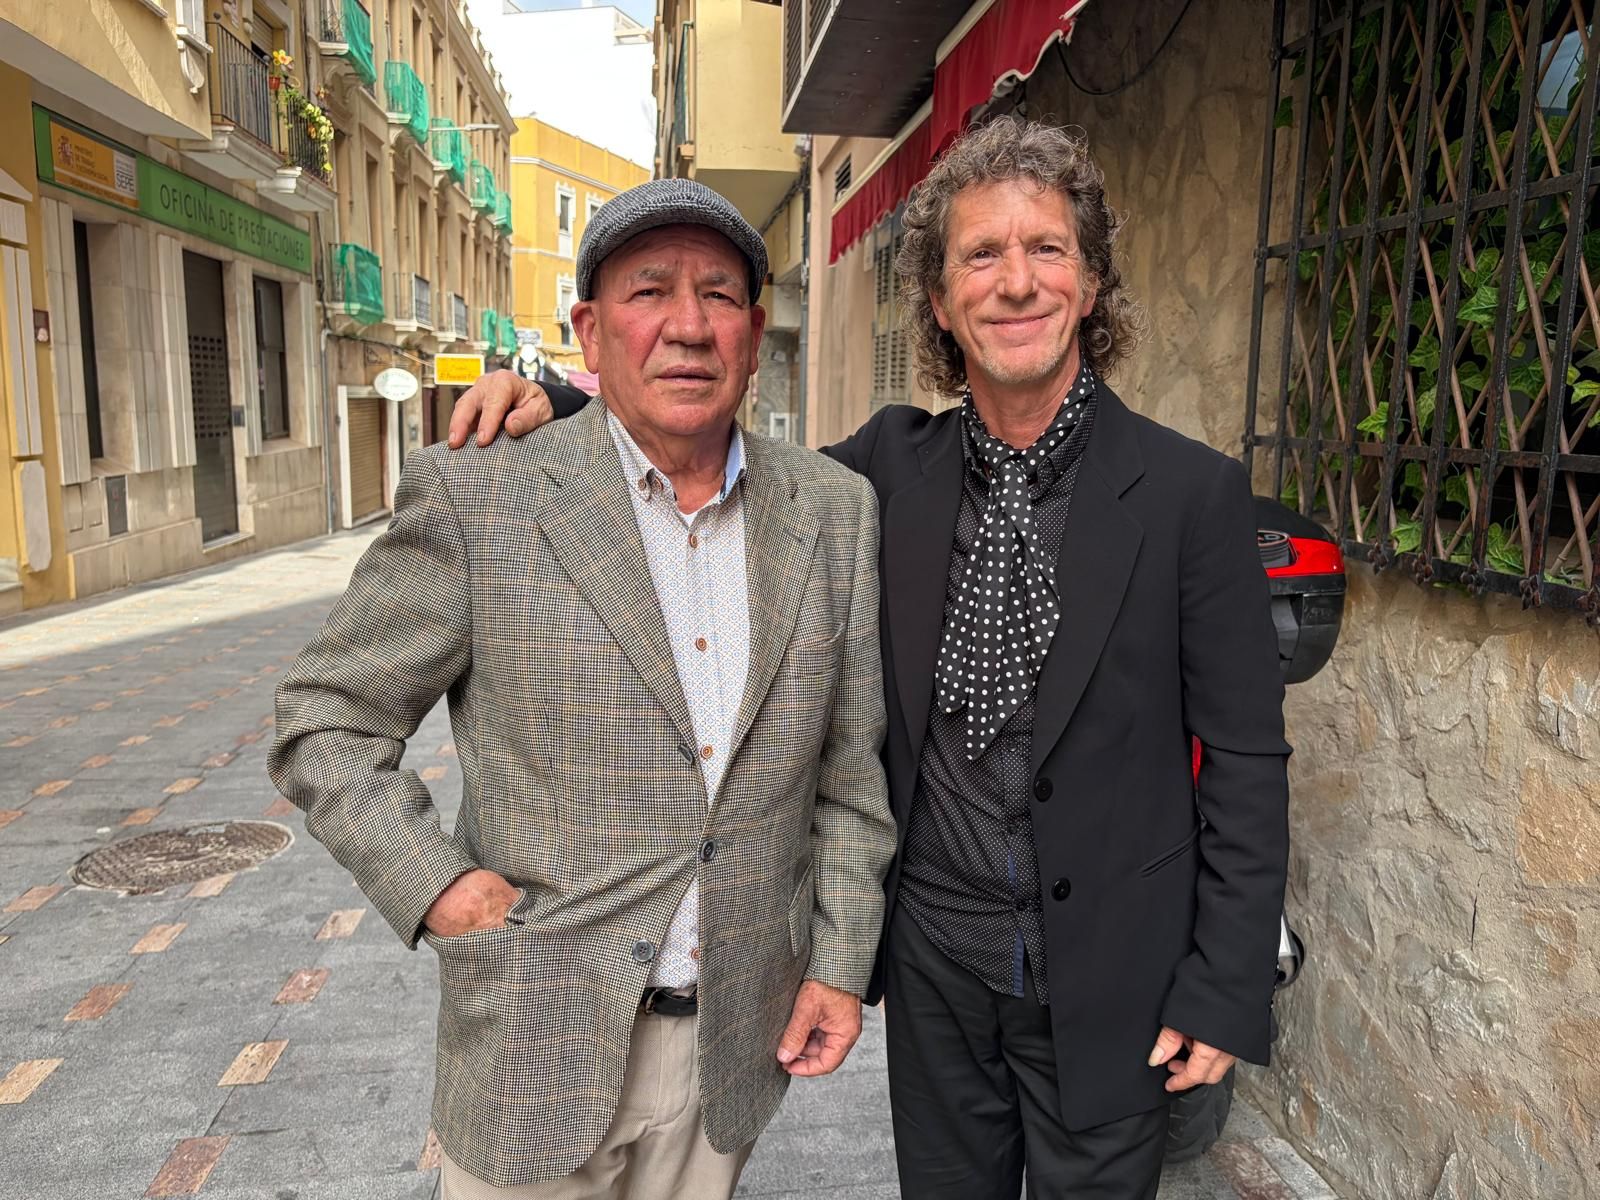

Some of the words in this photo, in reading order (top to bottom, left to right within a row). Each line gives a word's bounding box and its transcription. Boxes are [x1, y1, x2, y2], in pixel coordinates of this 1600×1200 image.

[116, 173, 134, 192] SEPE
[160, 184, 216, 228] OFICINA
[220, 209, 235, 235] DE
[238, 216, 305, 263] PRESTACIONES
